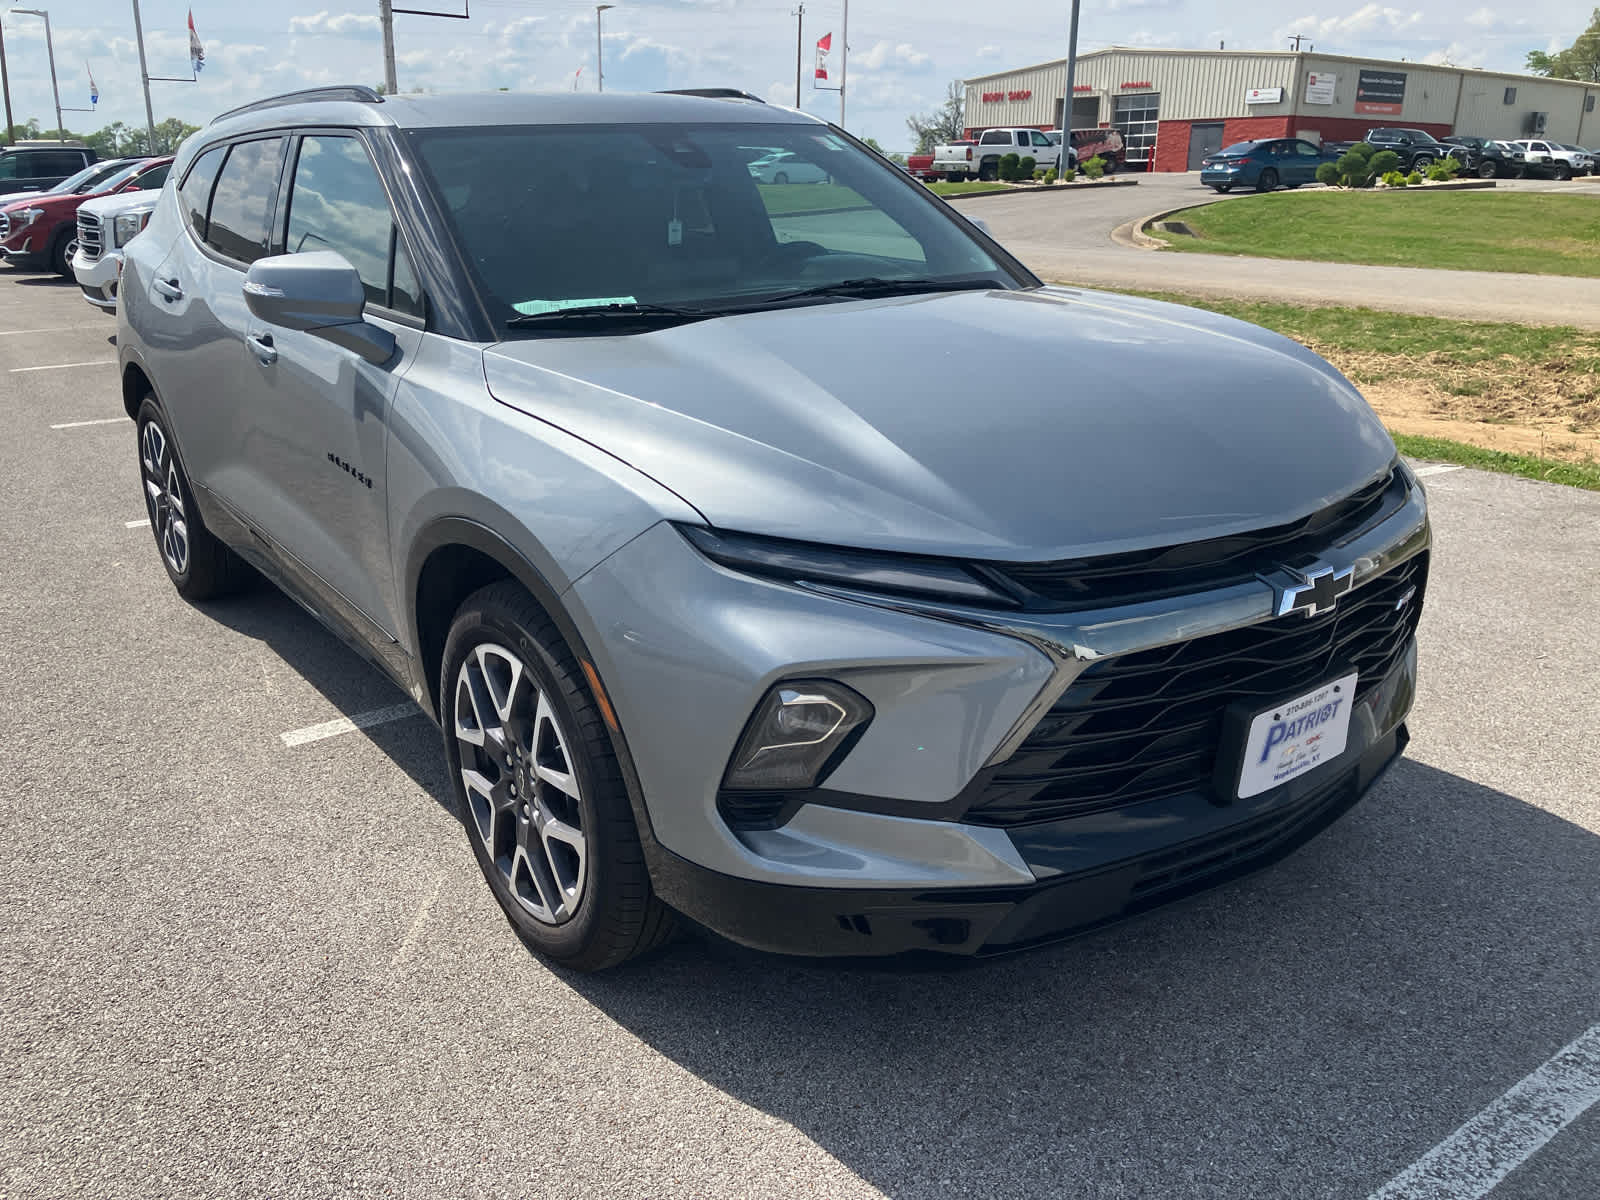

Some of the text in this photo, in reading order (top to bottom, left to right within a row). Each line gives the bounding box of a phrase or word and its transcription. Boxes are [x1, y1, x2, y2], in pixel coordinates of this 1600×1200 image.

[983, 89, 1032, 103] BODY SHOP
[1257, 697, 1344, 766] PATRIOT
